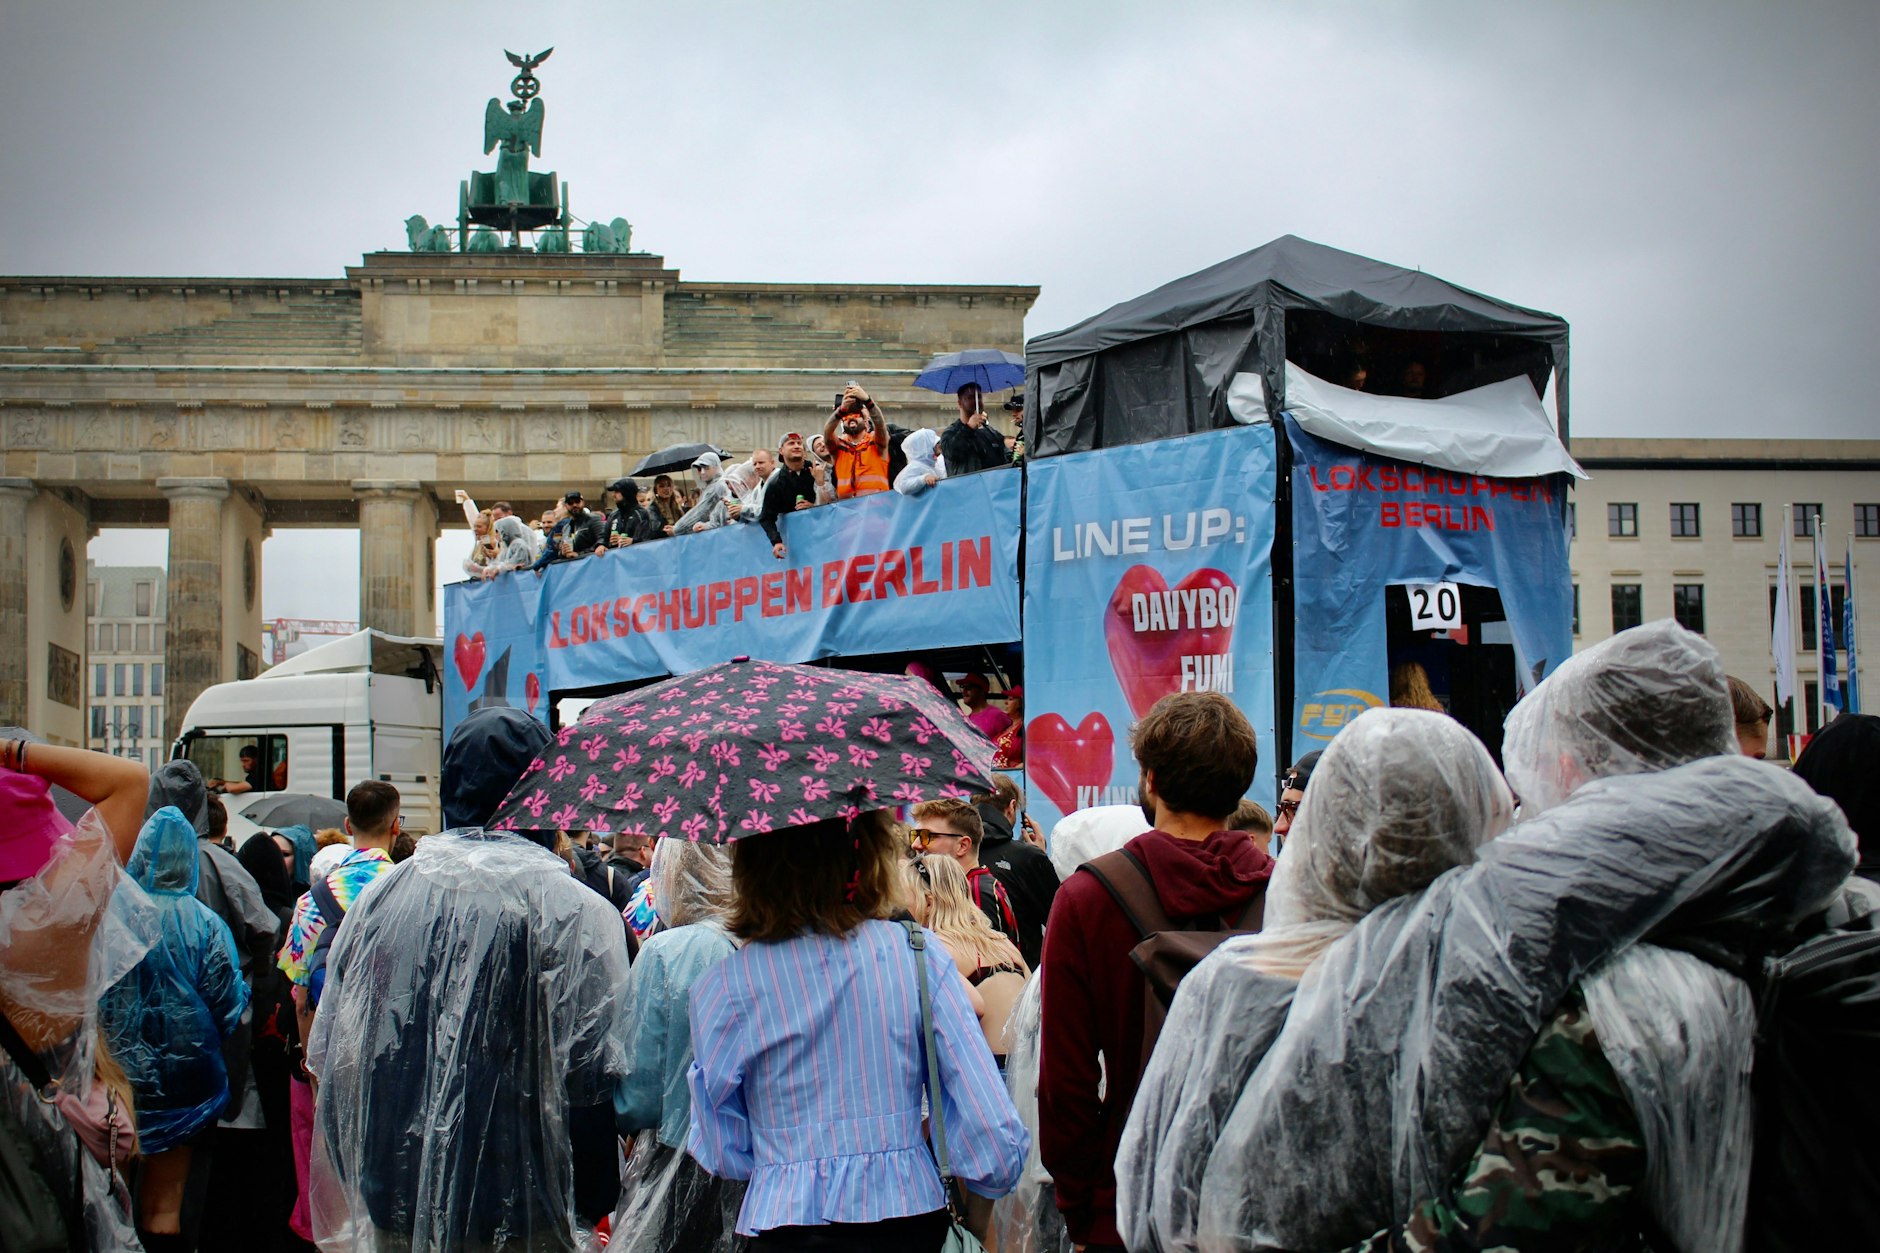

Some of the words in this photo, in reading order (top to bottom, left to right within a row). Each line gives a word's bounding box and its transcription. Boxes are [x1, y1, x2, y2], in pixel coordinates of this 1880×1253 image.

[1309, 464, 1552, 504] LOKSCHUPPEN
[1053, 517, 1152, 562] LINE
[1163, 507, 1246, 551] UP:
[1380, 502, 1495, 532] BERLIN
[548, 565, 813, 649] LOKSCHUPPEN
[821, 535, 992, 609] BERLIN
[1412, 588, 1457, 621] 20
[1180, 652, 1234, 694] FUMI
